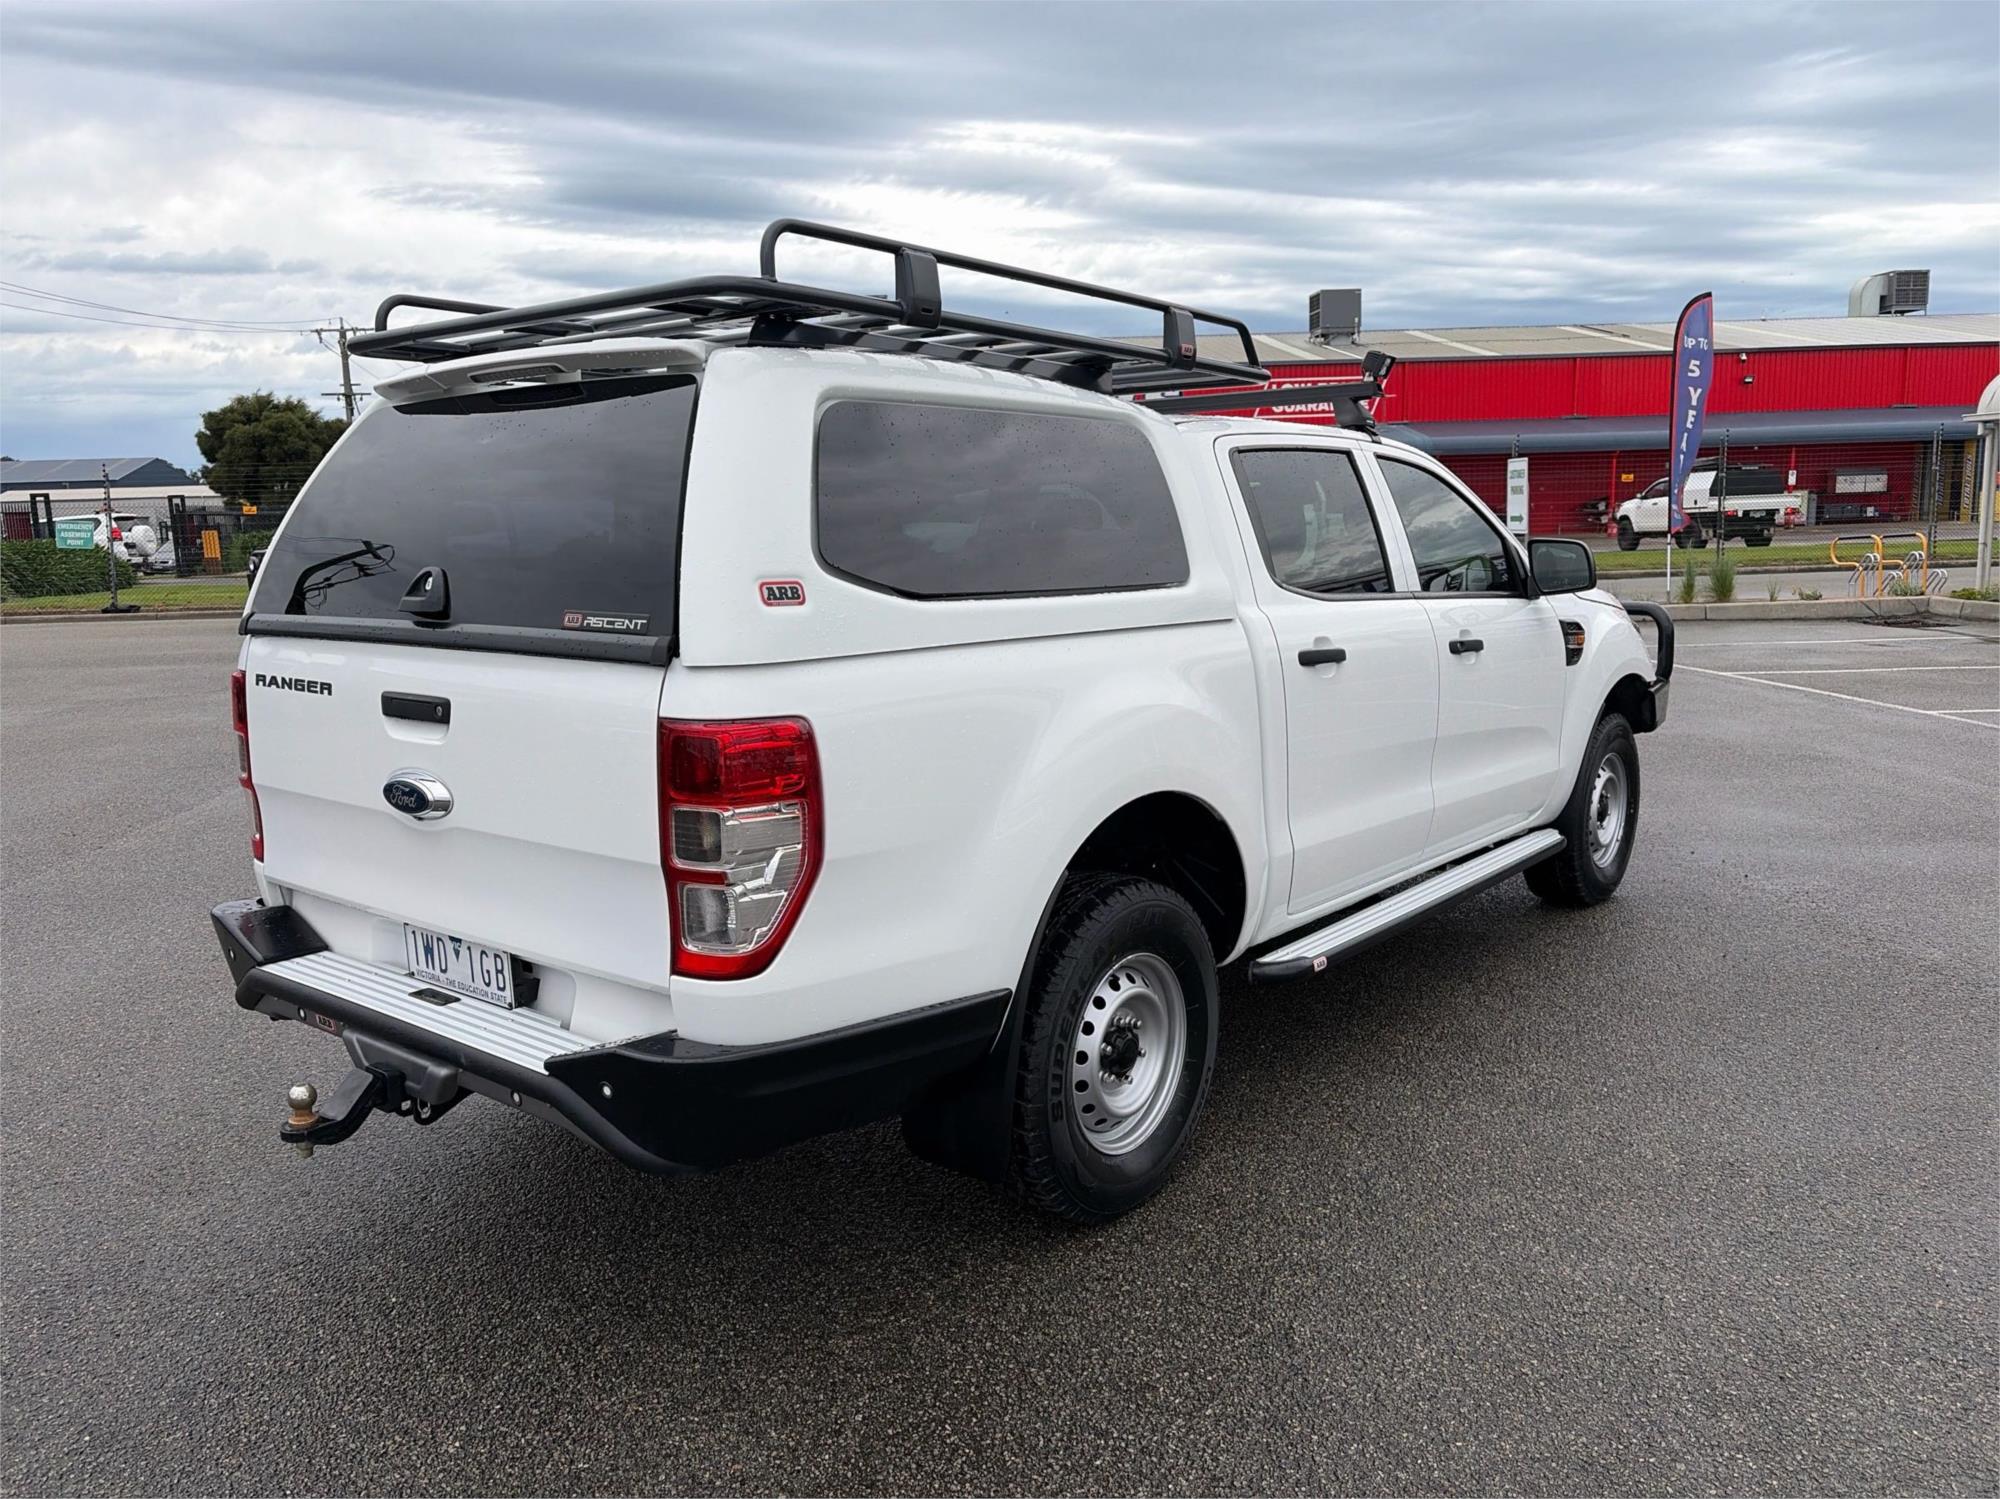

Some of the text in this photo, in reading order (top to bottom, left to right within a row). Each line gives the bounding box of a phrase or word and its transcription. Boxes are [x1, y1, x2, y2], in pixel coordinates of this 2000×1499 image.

[1687, 359, 1701, 378] 5
[60, 530, 92, 538] ASSEMBLY
[766, 585, 802, 602] ARB
[583, 616, 648, 630] ASCENT
[255, 673, 333, 696] RANGER
[390, 783, 418, 809] Ford
[411, 929, 507, 993] 1WD 1GB
[416, 967, 442, 983] VICTORIA
[446, 977, 458, 988] THE
[458, 981, 490, 999] EDUCATION
[490, 991, 508, 1005] STATE
